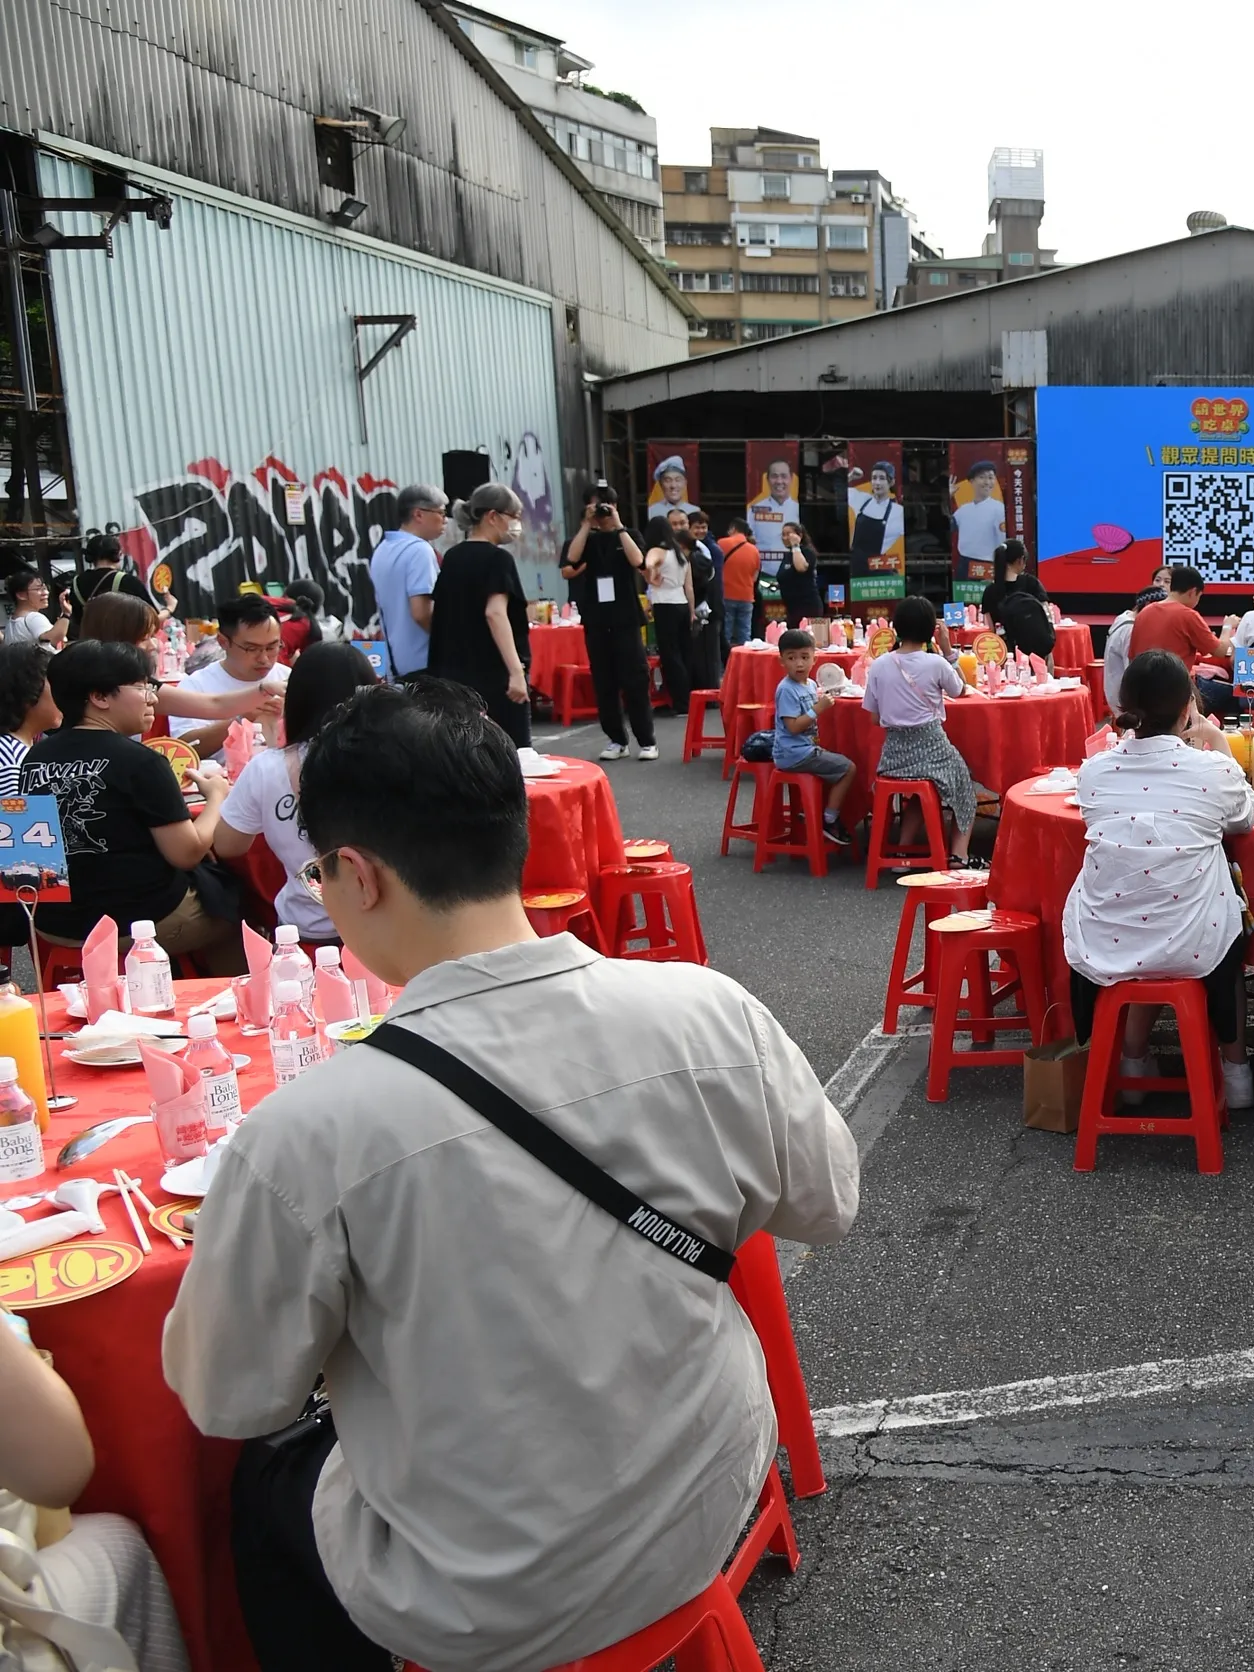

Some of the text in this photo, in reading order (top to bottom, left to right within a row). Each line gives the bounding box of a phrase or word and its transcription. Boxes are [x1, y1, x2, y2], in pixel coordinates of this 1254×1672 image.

[945, 611, 963, 621] 13
[213, 1081, 237, 1095] Babu
[210, 1088, 238, 1107] Long
[0, 1134, 32, 1148] Babu
[627, 1205, 706, 1263] PALLADIUM
